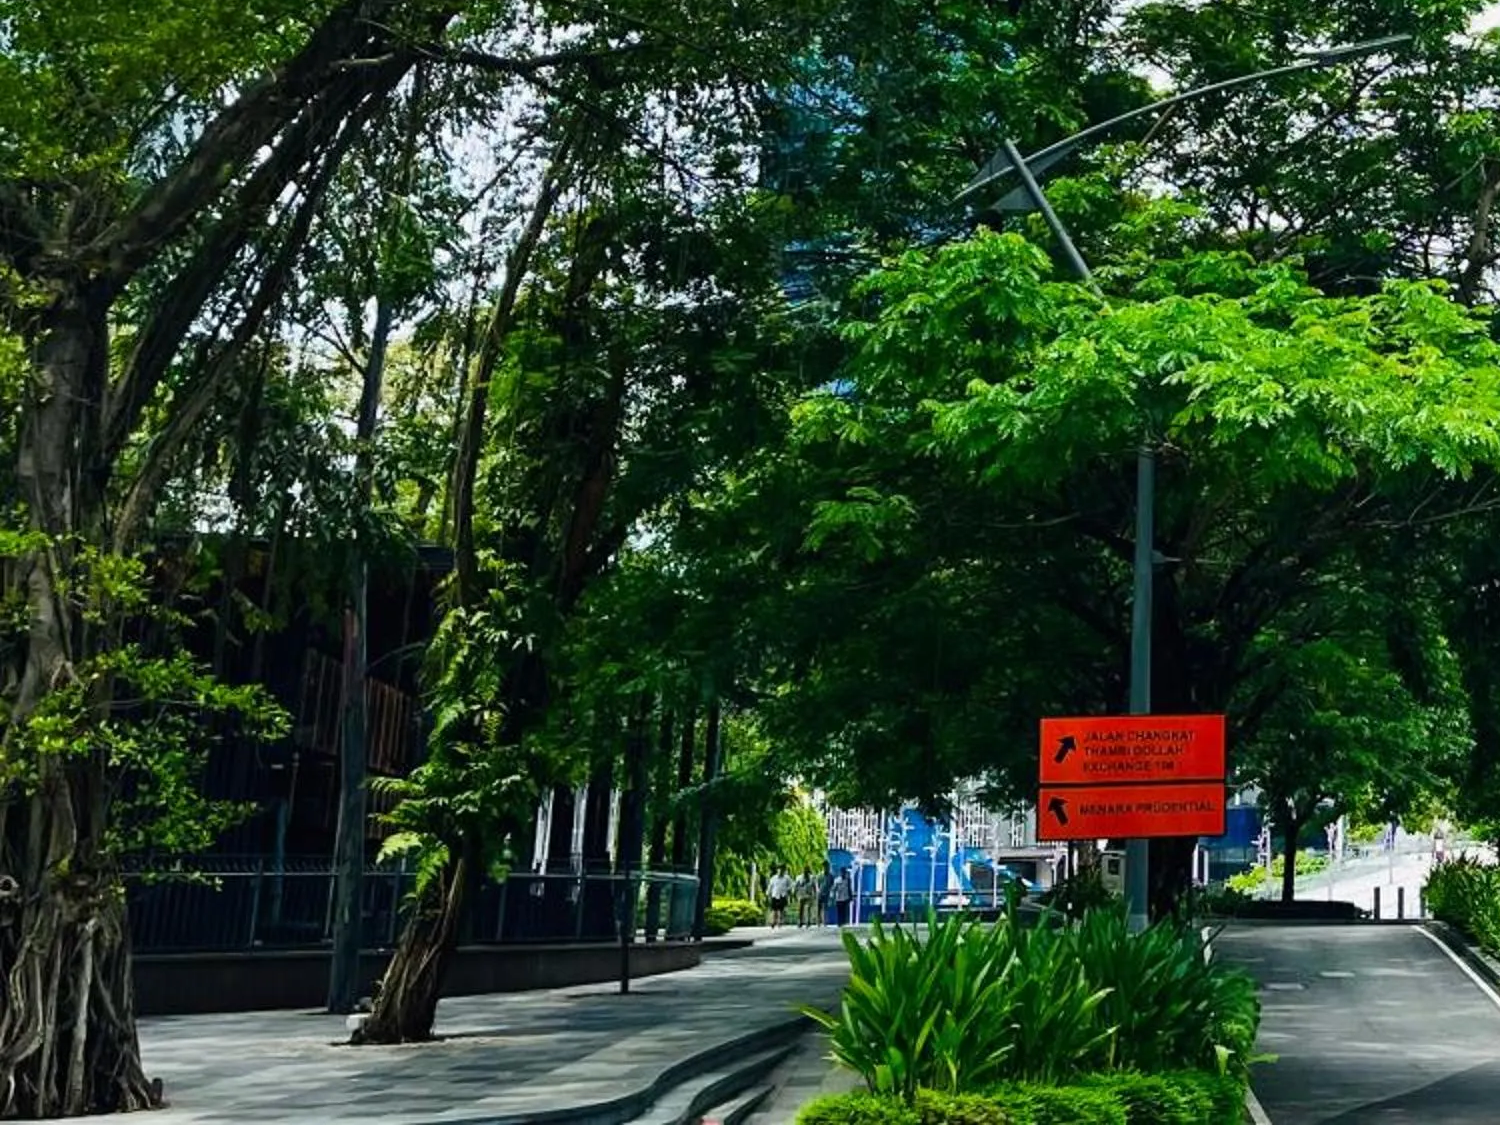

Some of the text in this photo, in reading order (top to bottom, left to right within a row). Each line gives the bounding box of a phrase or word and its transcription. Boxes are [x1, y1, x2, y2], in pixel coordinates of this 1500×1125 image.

[1084, 730, 1195, 742] JALAN CHANGKAT
[1131, 745, 1183, 756] DOLLAH
[1082, 761, 1153, 773] EXCHANGE
[1079, 801, 1215, 816] MENARA PRUDENTIAL
